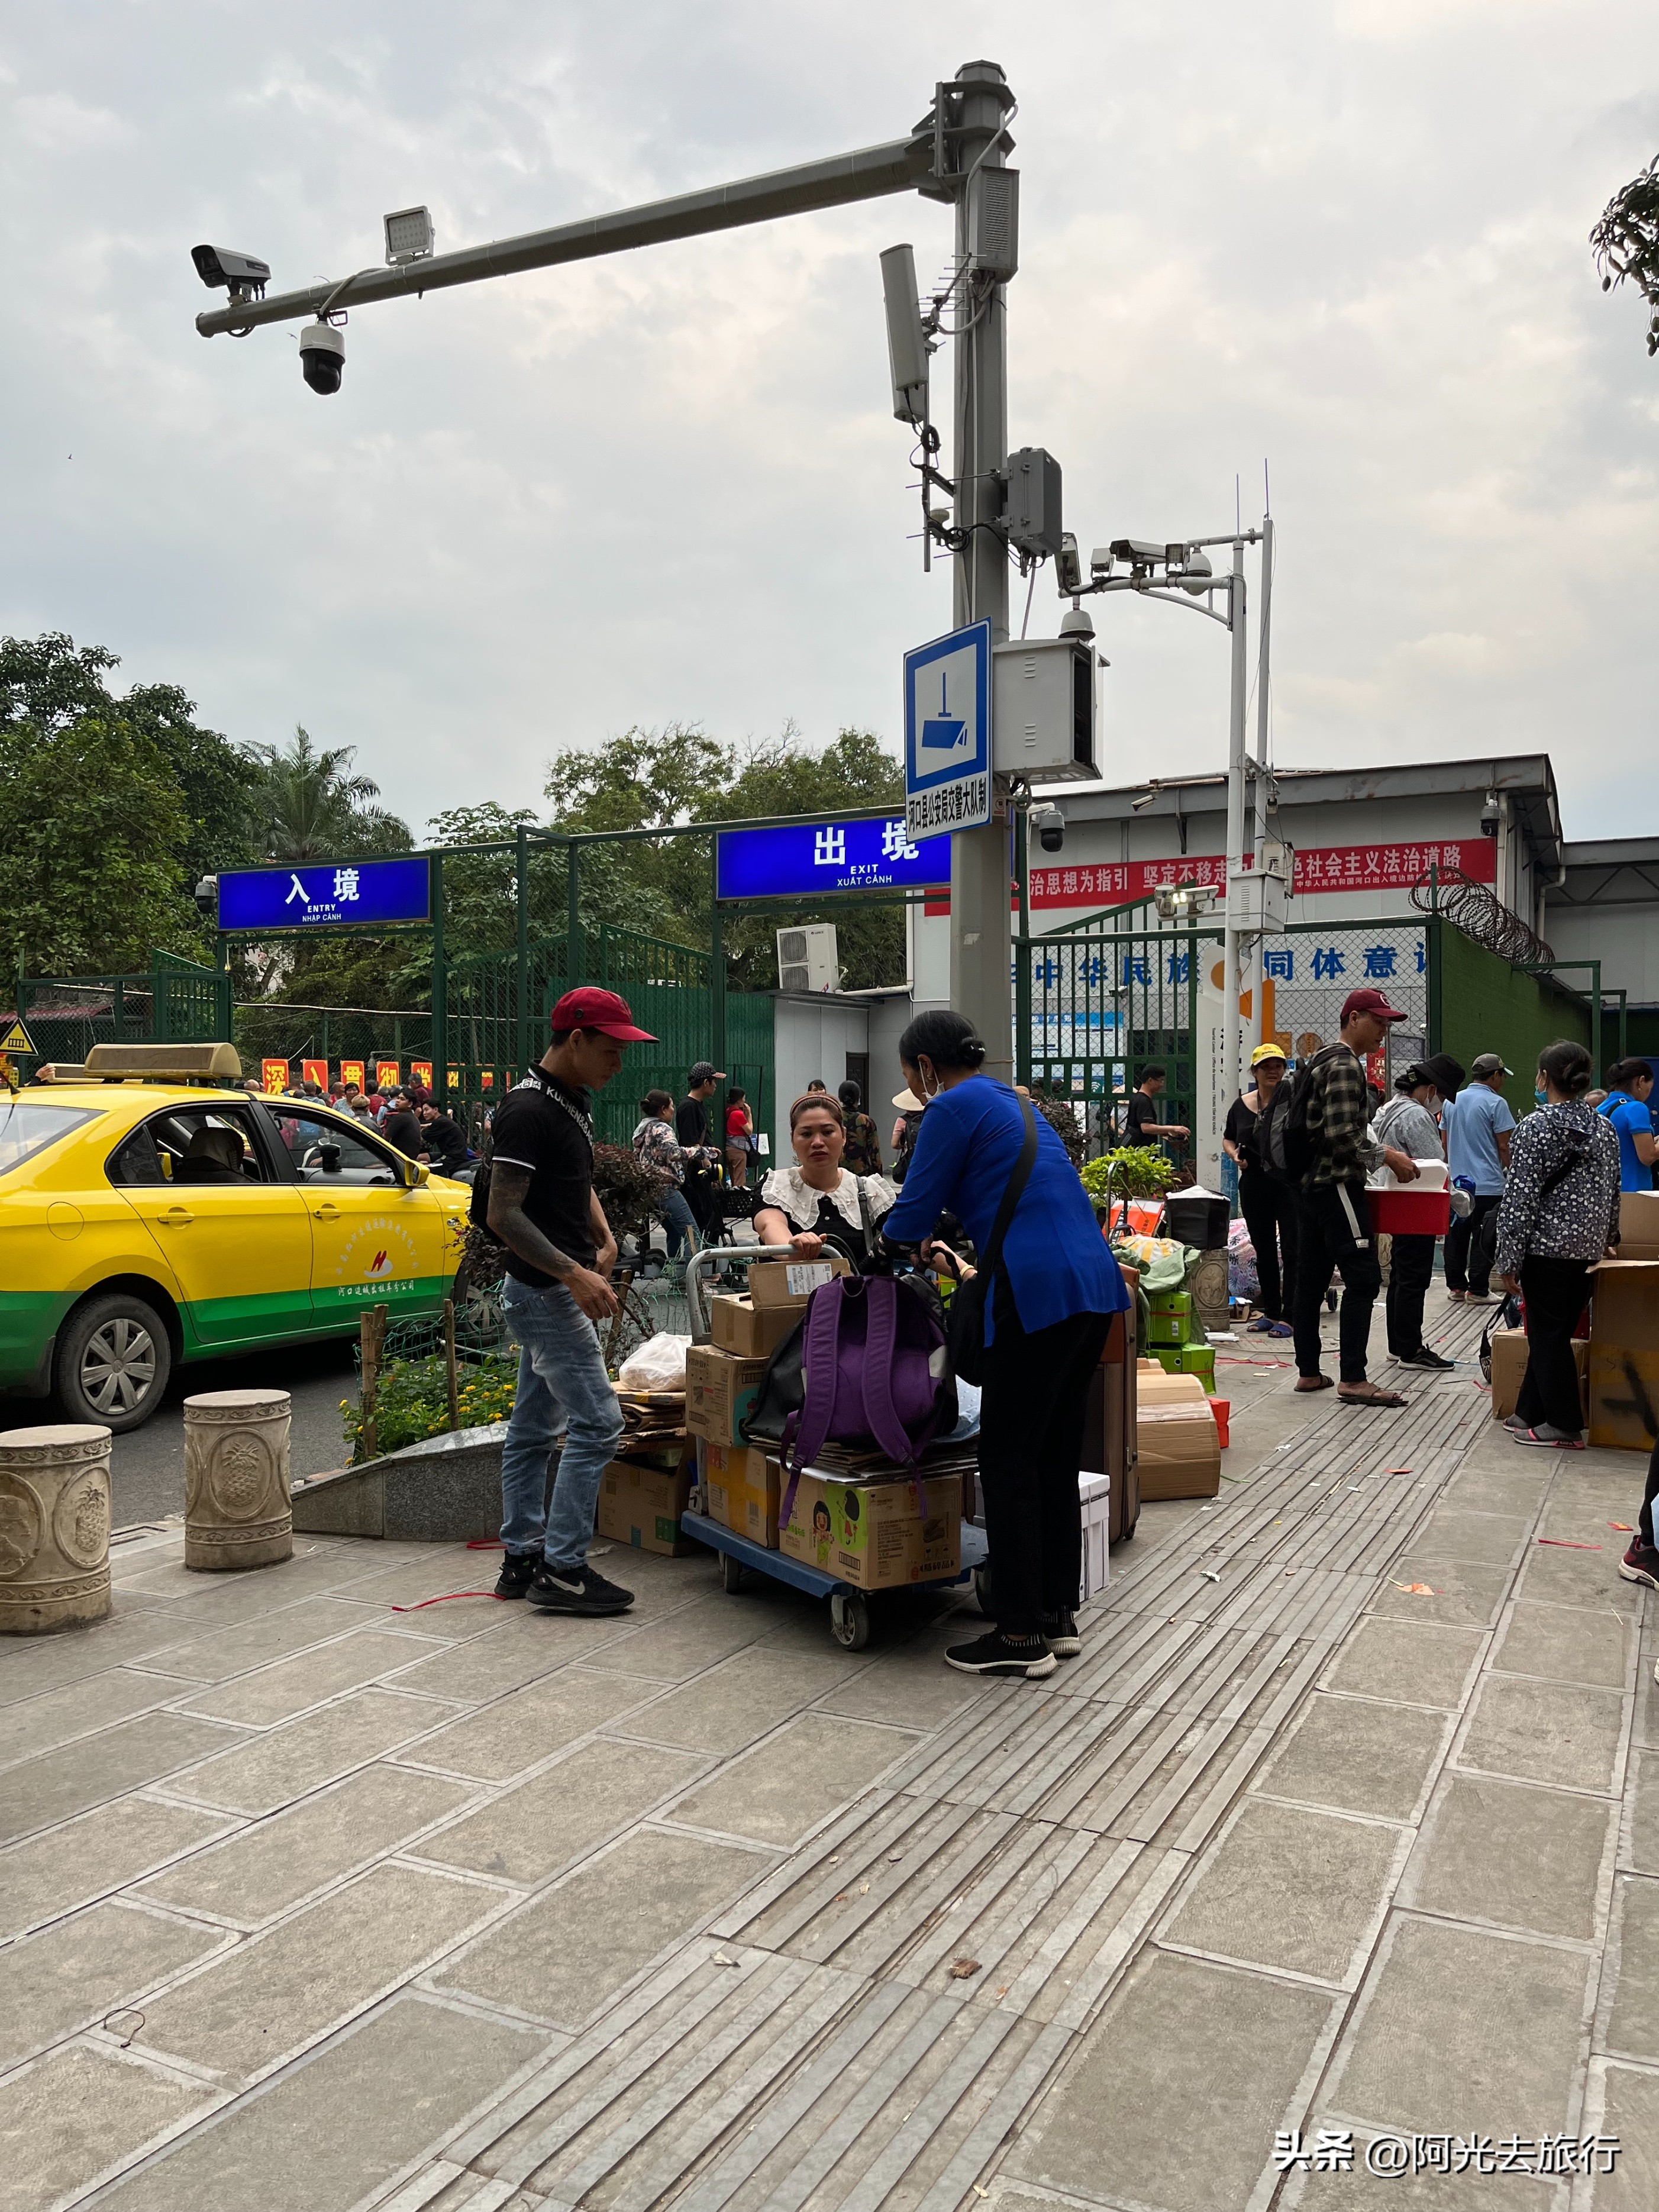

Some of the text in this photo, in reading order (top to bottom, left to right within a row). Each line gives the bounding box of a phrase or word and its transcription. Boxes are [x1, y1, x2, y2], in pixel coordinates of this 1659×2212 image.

[909, 778, 986, 833] 河口县公安局交警大队制
[814, 820, 919, 865] 出境
[285, 868, 360, 905] 入境
[850, 864, 879, 875] EXIT
[1011, 844, 1461, 897] 治思想为指引 坚定不移走色社会主义法治道路
[307, 904, 336, 913] ENTRY
